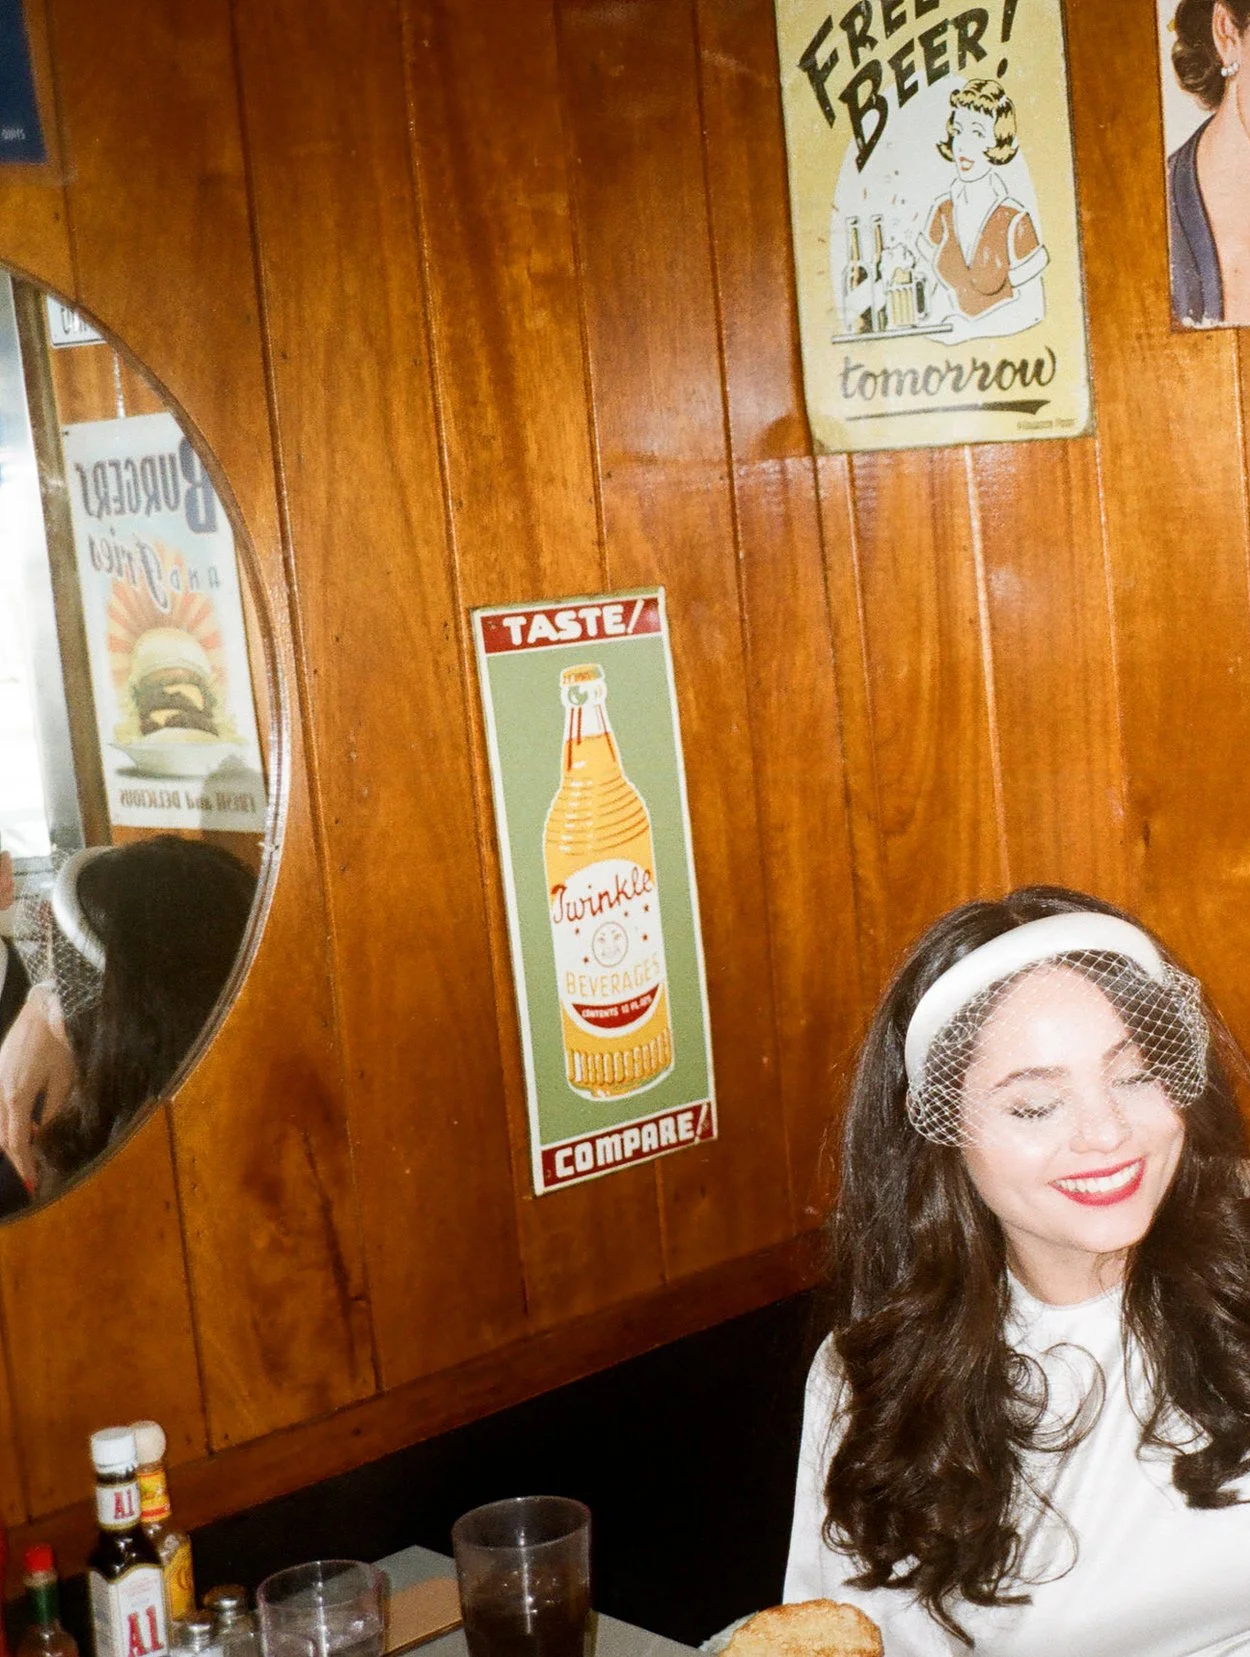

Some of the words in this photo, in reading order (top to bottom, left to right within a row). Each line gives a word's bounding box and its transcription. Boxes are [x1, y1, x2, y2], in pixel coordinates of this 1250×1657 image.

[838, 345, 1057, 400] tomorrow
[551, 866, 653, 924] Twinkle
[564, 956, 660, 998] BEVERAGES
